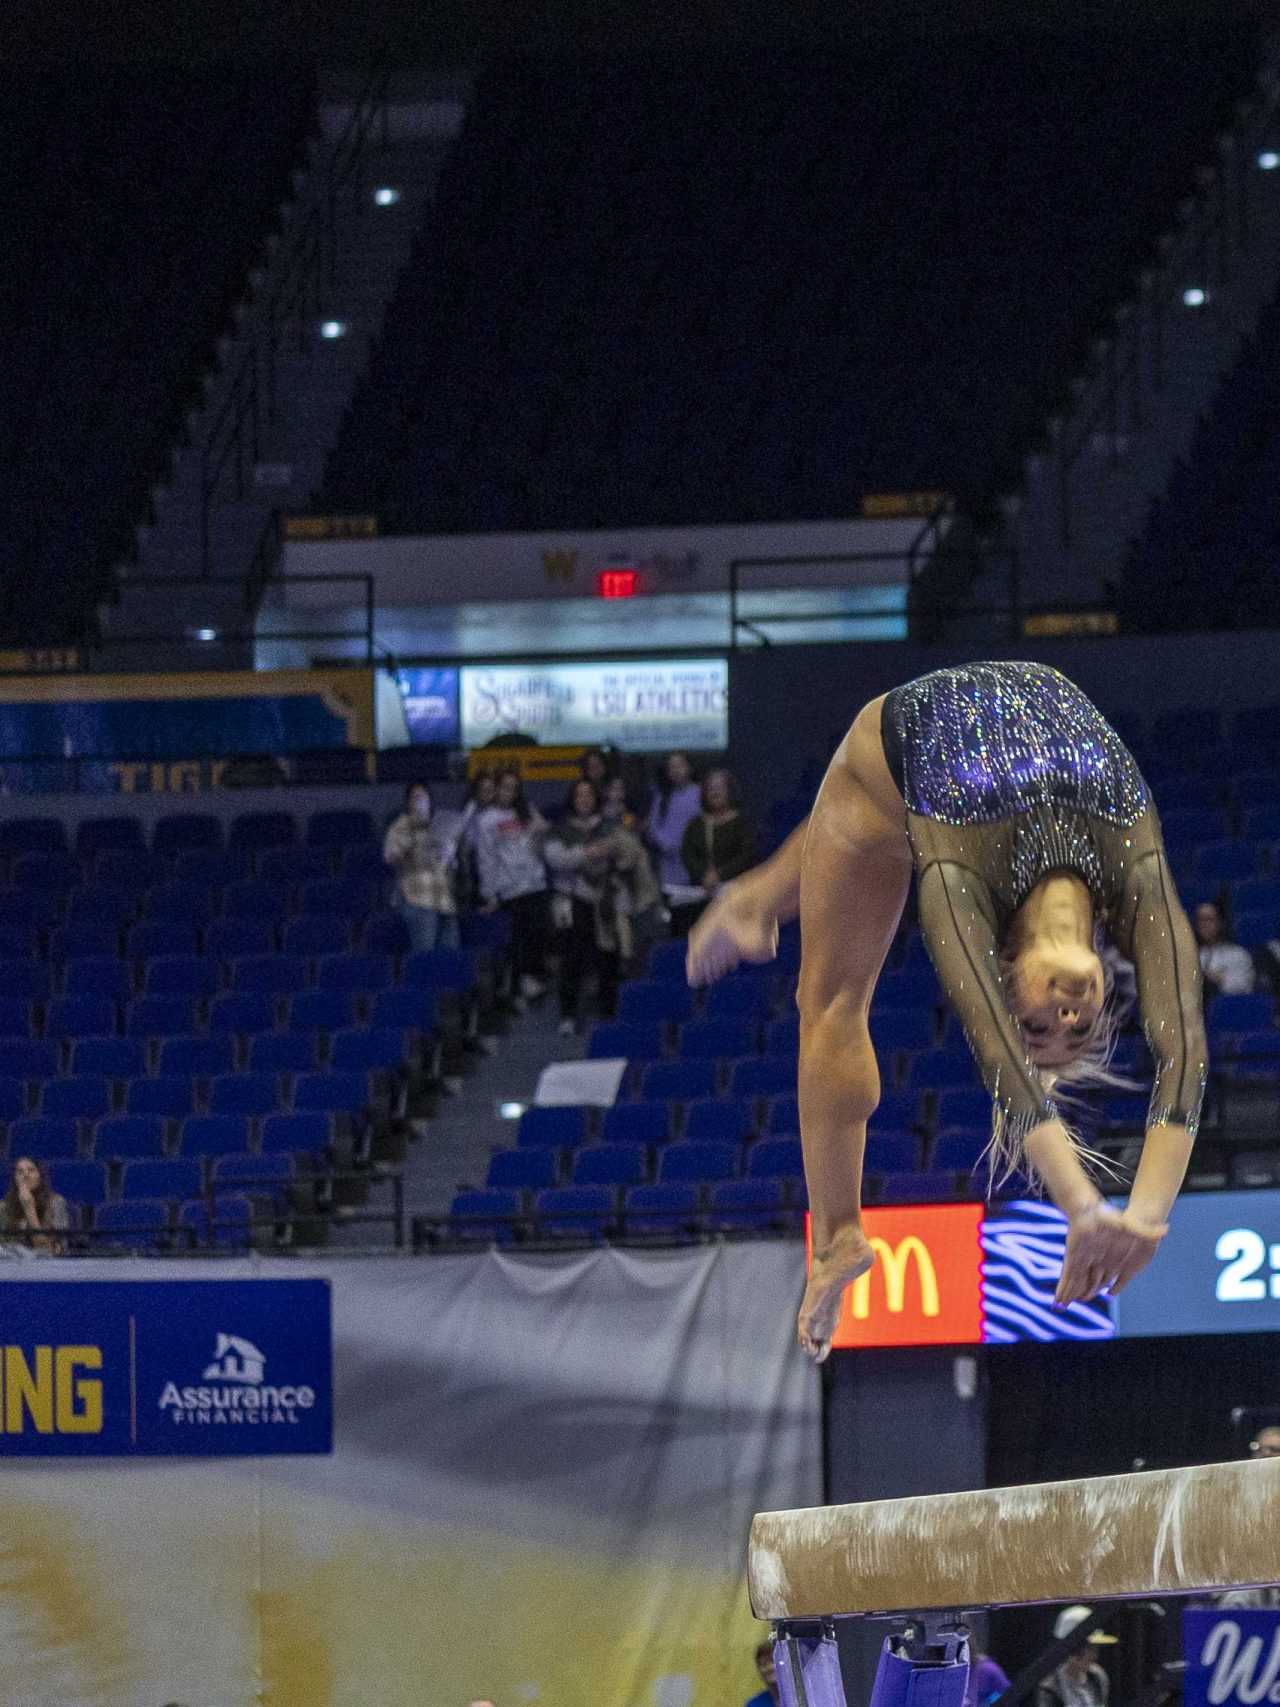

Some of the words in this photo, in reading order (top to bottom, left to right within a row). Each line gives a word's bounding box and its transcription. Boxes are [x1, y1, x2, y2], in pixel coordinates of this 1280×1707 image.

[0, 1345, 103, 1433] NG
[159, 1382, 315, 1409] Assurance
[173, 1409, 299, 1425] FINANCIAL
